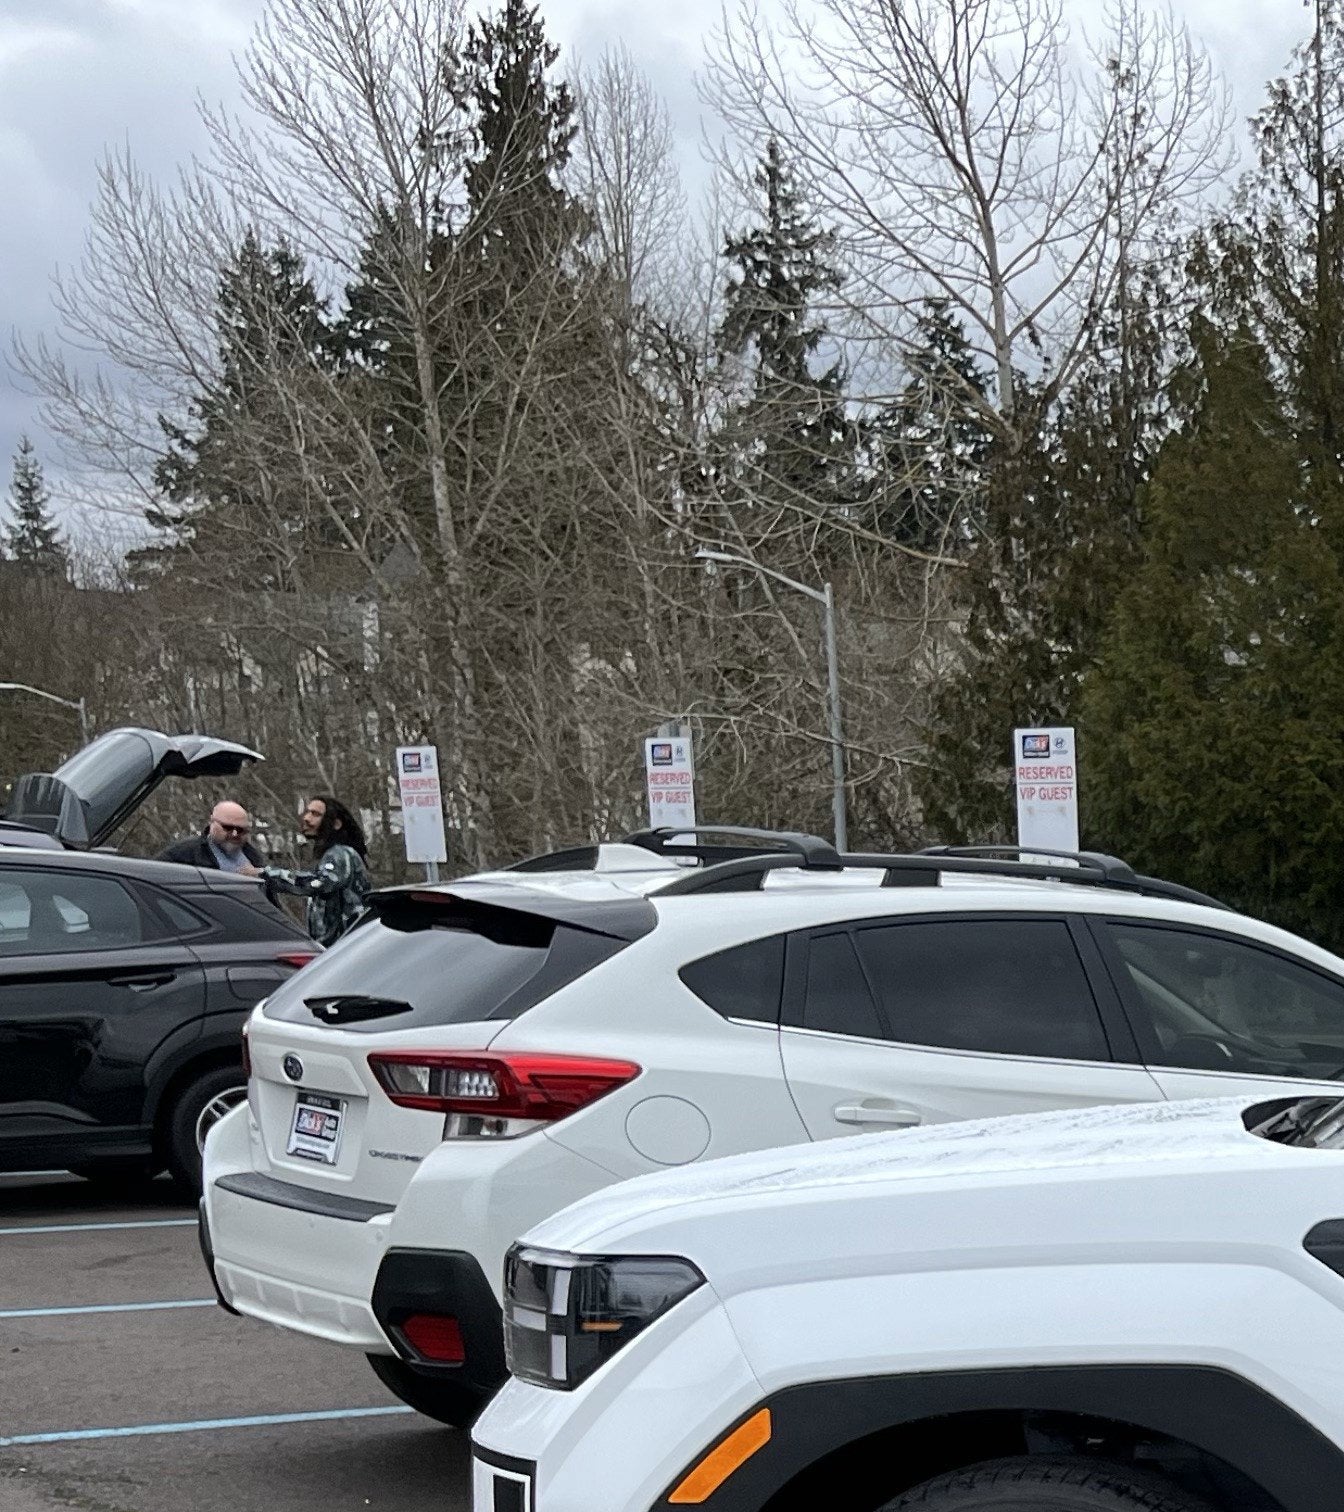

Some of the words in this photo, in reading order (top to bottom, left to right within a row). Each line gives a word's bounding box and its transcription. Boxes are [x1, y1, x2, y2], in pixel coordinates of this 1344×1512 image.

[1018, 766, 1073, 780] RESERVED
[1020, 786, 1036, 800] VIP
[1039, 786, 1073, 801] GUEST
